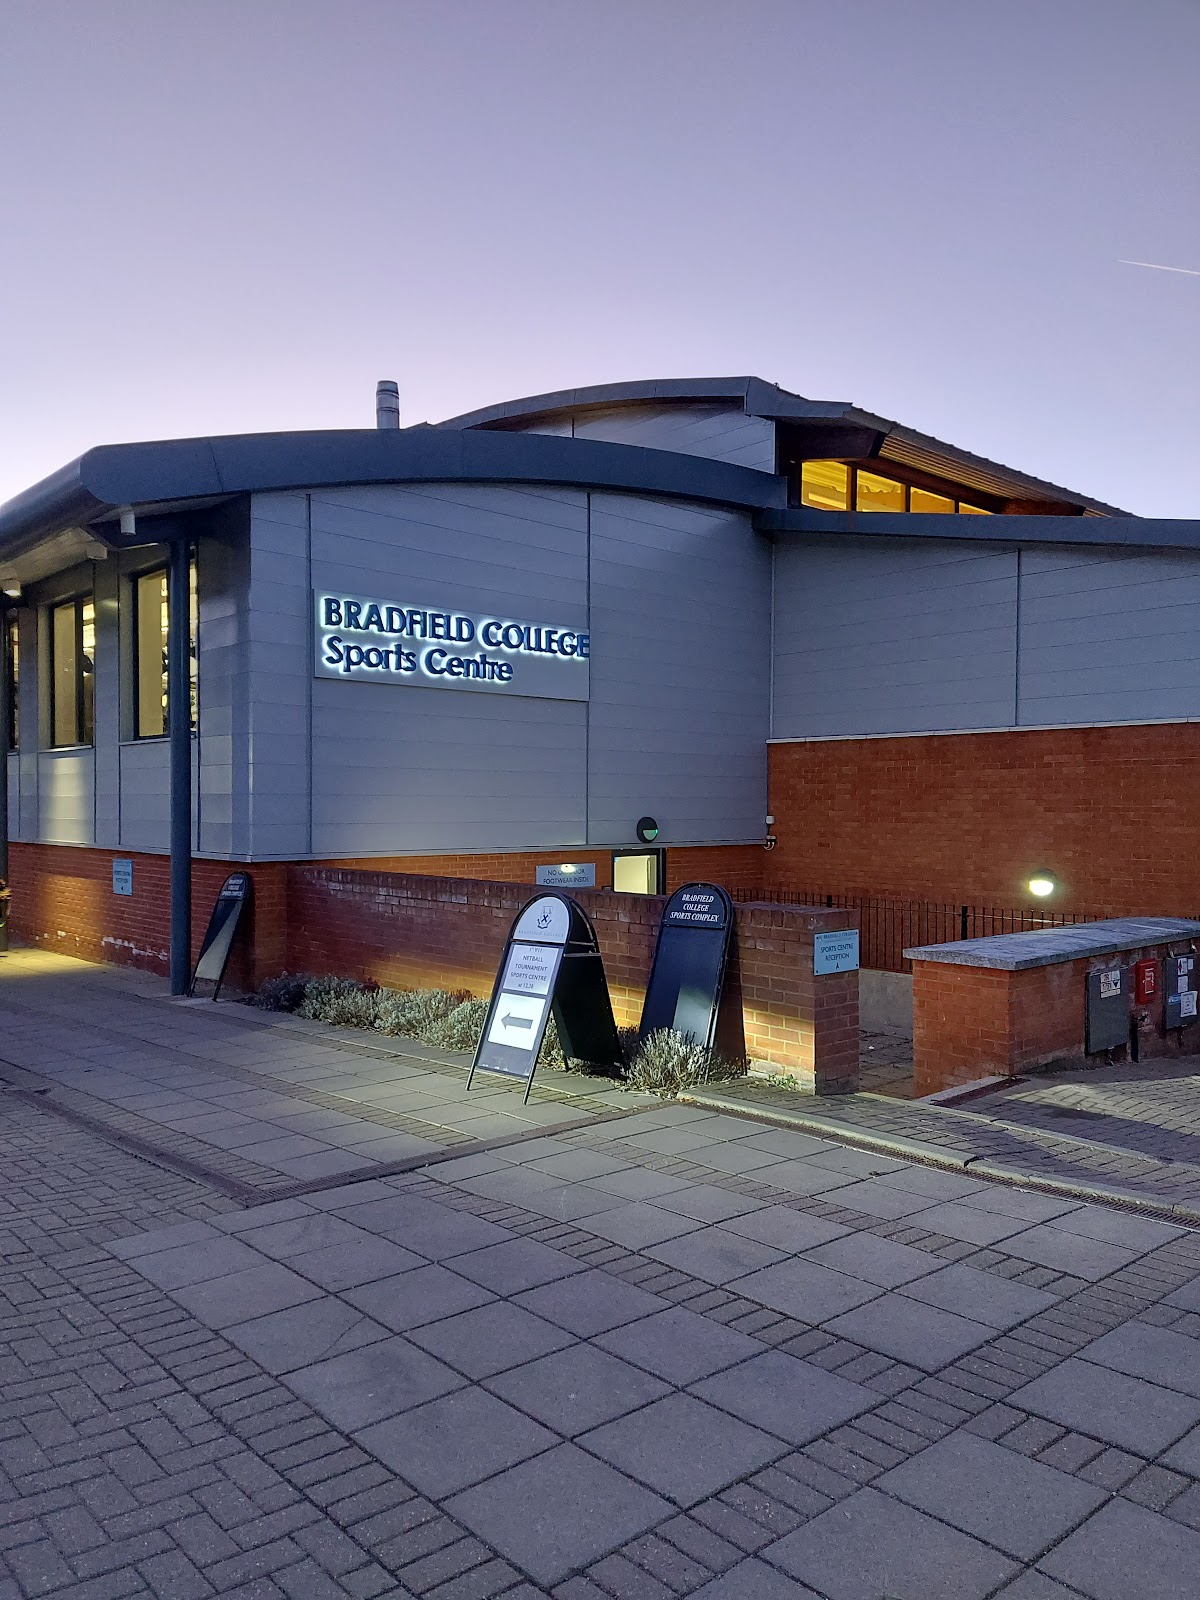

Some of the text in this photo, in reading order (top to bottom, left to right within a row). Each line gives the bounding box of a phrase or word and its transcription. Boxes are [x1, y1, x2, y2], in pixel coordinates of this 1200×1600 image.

[324, 598, 589, 658] BRADFIELD COLLEGE
[326, 636, 514, 681] Sports Centre
[543, 877, 572, 885] FOOTWEAR
[682, 894, 714, 902] BRADFIELD
[683, 903, 709, 911] COLLEGE
[670, 912, 719, 922] SPORTS COMPLEX
[820, 943, 854, 953] SPORTS CENTRE
[825, 953, 850, 961] RECEPTION
[515, 963, 548, 971] TOURNAMENT
